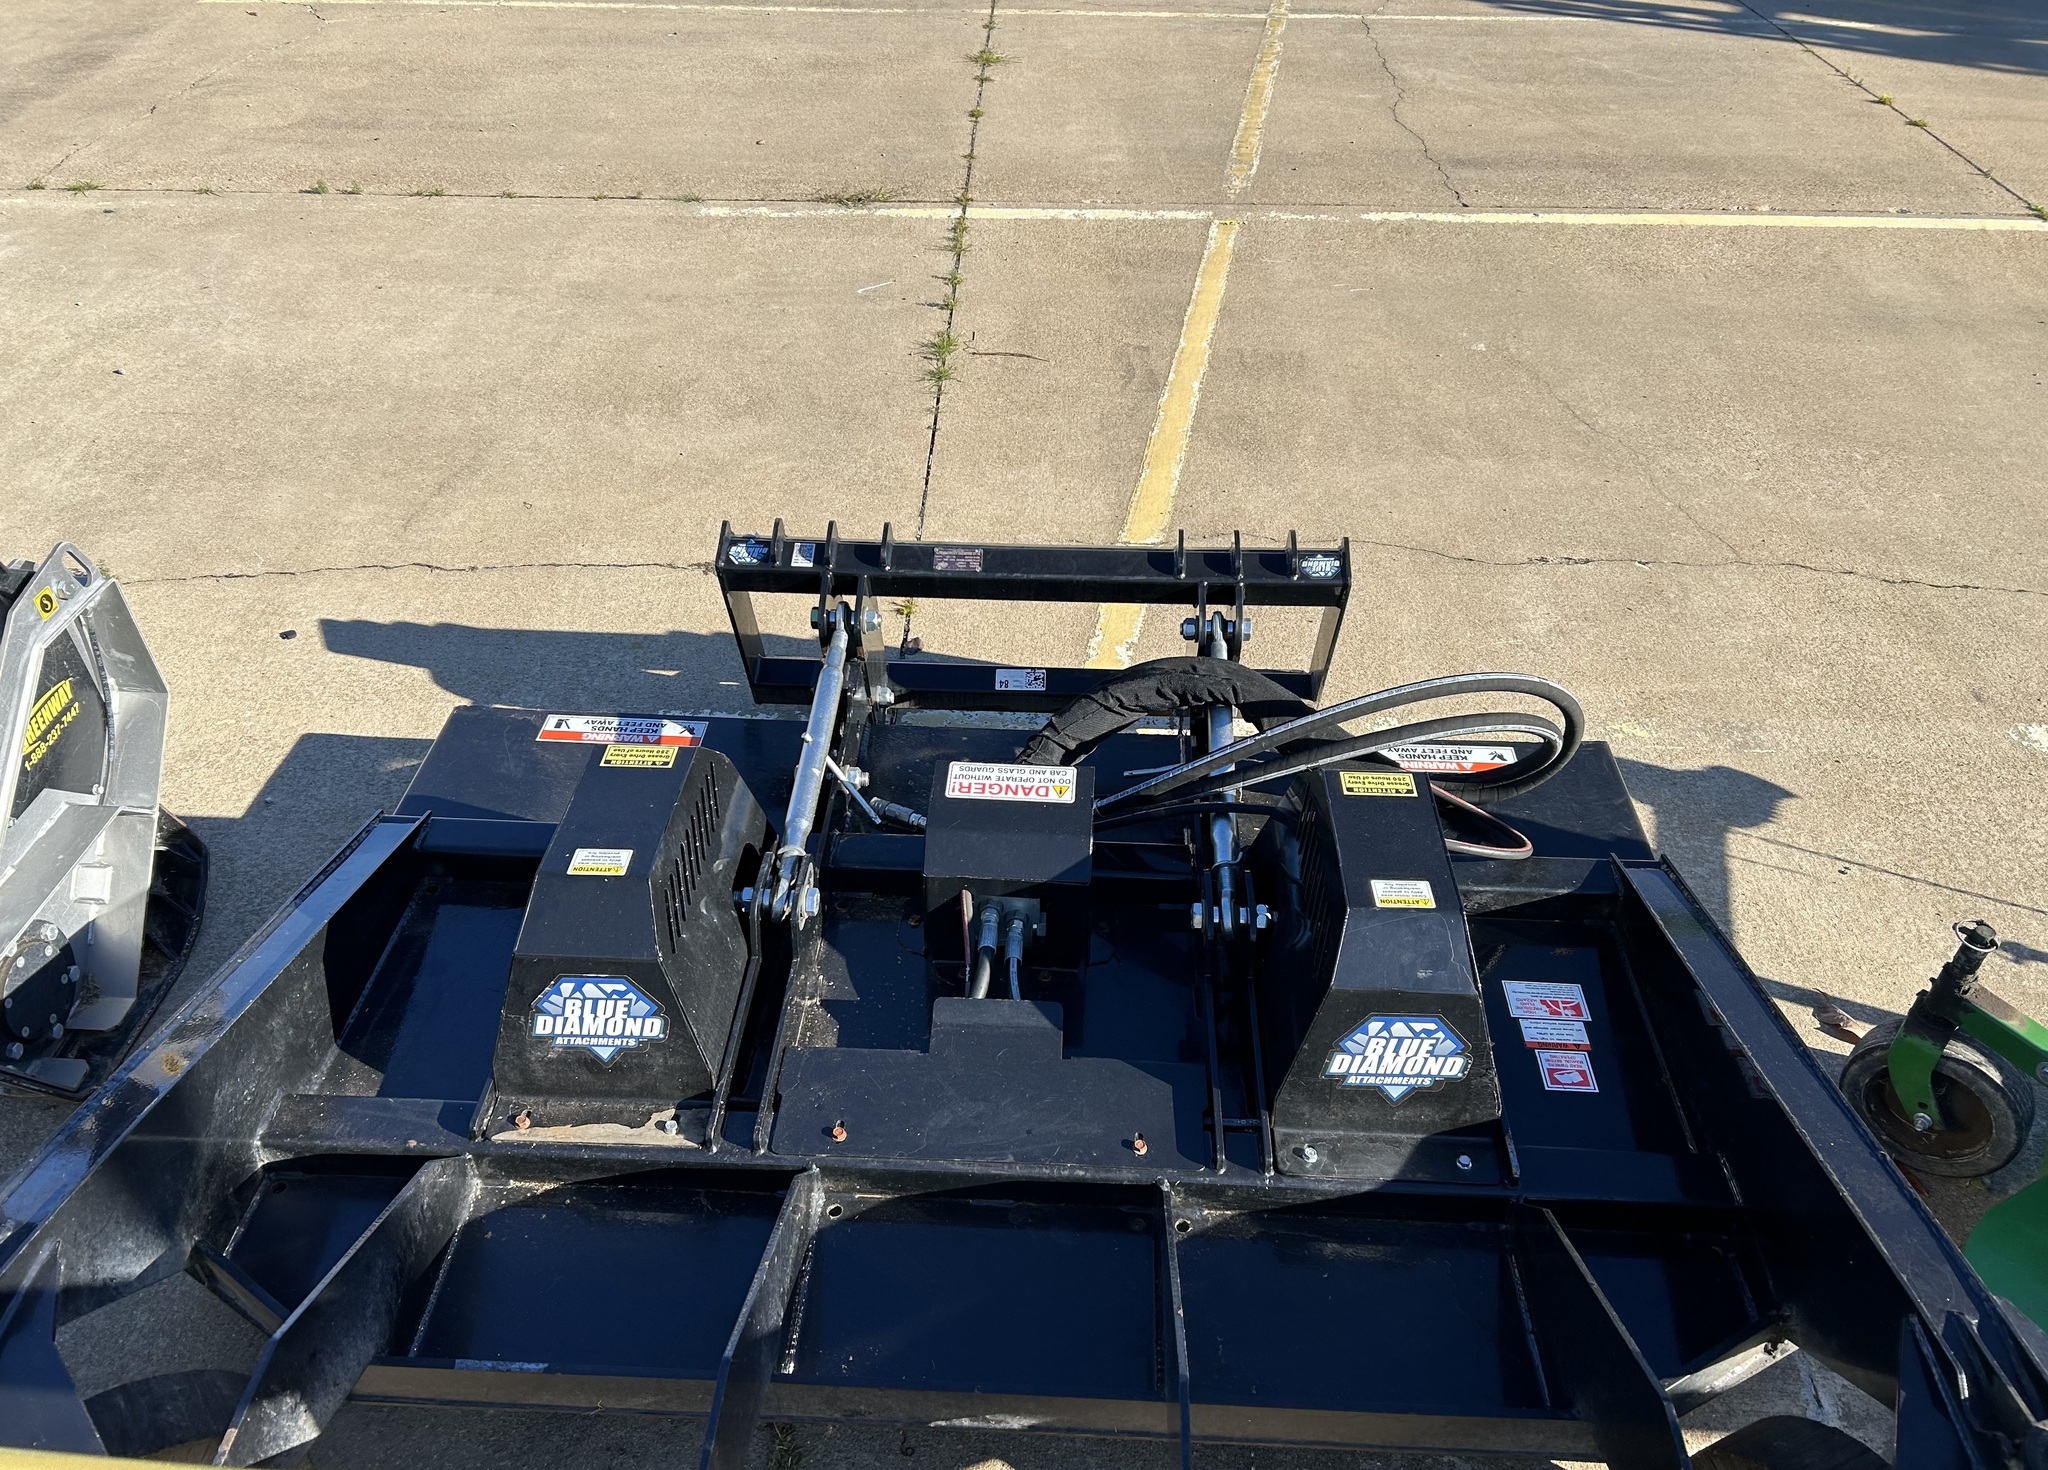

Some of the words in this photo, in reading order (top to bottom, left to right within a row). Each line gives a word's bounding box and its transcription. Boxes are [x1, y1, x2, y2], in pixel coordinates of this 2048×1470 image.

[999, 680, 1009, 689] 84
[23, 680, 72, 752] REENWAY
[25, 702, 80, 771] 1-888-237-7447
[582, 732, 644, 742] WARNING
[951, 782, 1050, 797] DANGER!
[564, 998, 631, 1018] BLUE
[535, 1016, 662, 1036] DIAMOND
[555, 1037, 636, 1046] ATTACHMENTS
[1364, 1038, 1437, 1058] BLUE
[1329, 1054, 1464, 1076] DIAMOND
[1346, 1076, 1432, 1085] ATTACHMENTS
